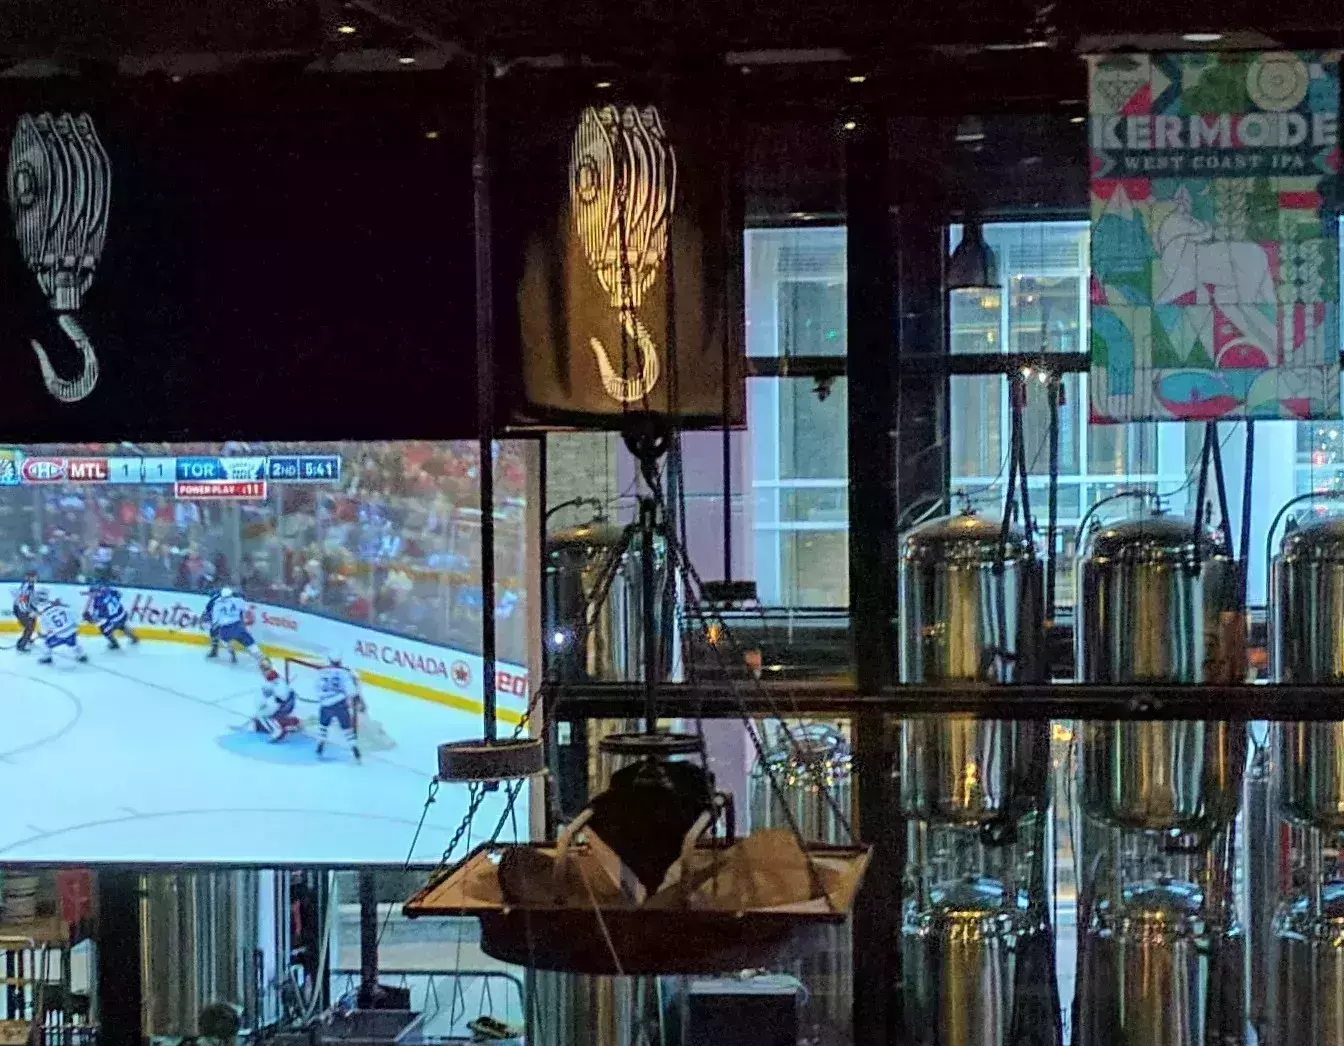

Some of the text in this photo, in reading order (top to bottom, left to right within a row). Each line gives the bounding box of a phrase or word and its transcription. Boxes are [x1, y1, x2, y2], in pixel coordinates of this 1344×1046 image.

[1092, 112, 1337, 148] KERMODE
[1124, 155, 1304, 169] WEST COAST IPA
[71, 463, 105, 478] MTL
[122, 463, 129, 477] 1
[157, 463, 164, 477] 1
[181, 462, 215, 477] TOR
[272, 462, 296, 477] 2ND
[179, 484, 210, 494] POWER
[212, 484, 235, 494] PLAY
[354, 640, 449, 679] AIR CANADA
